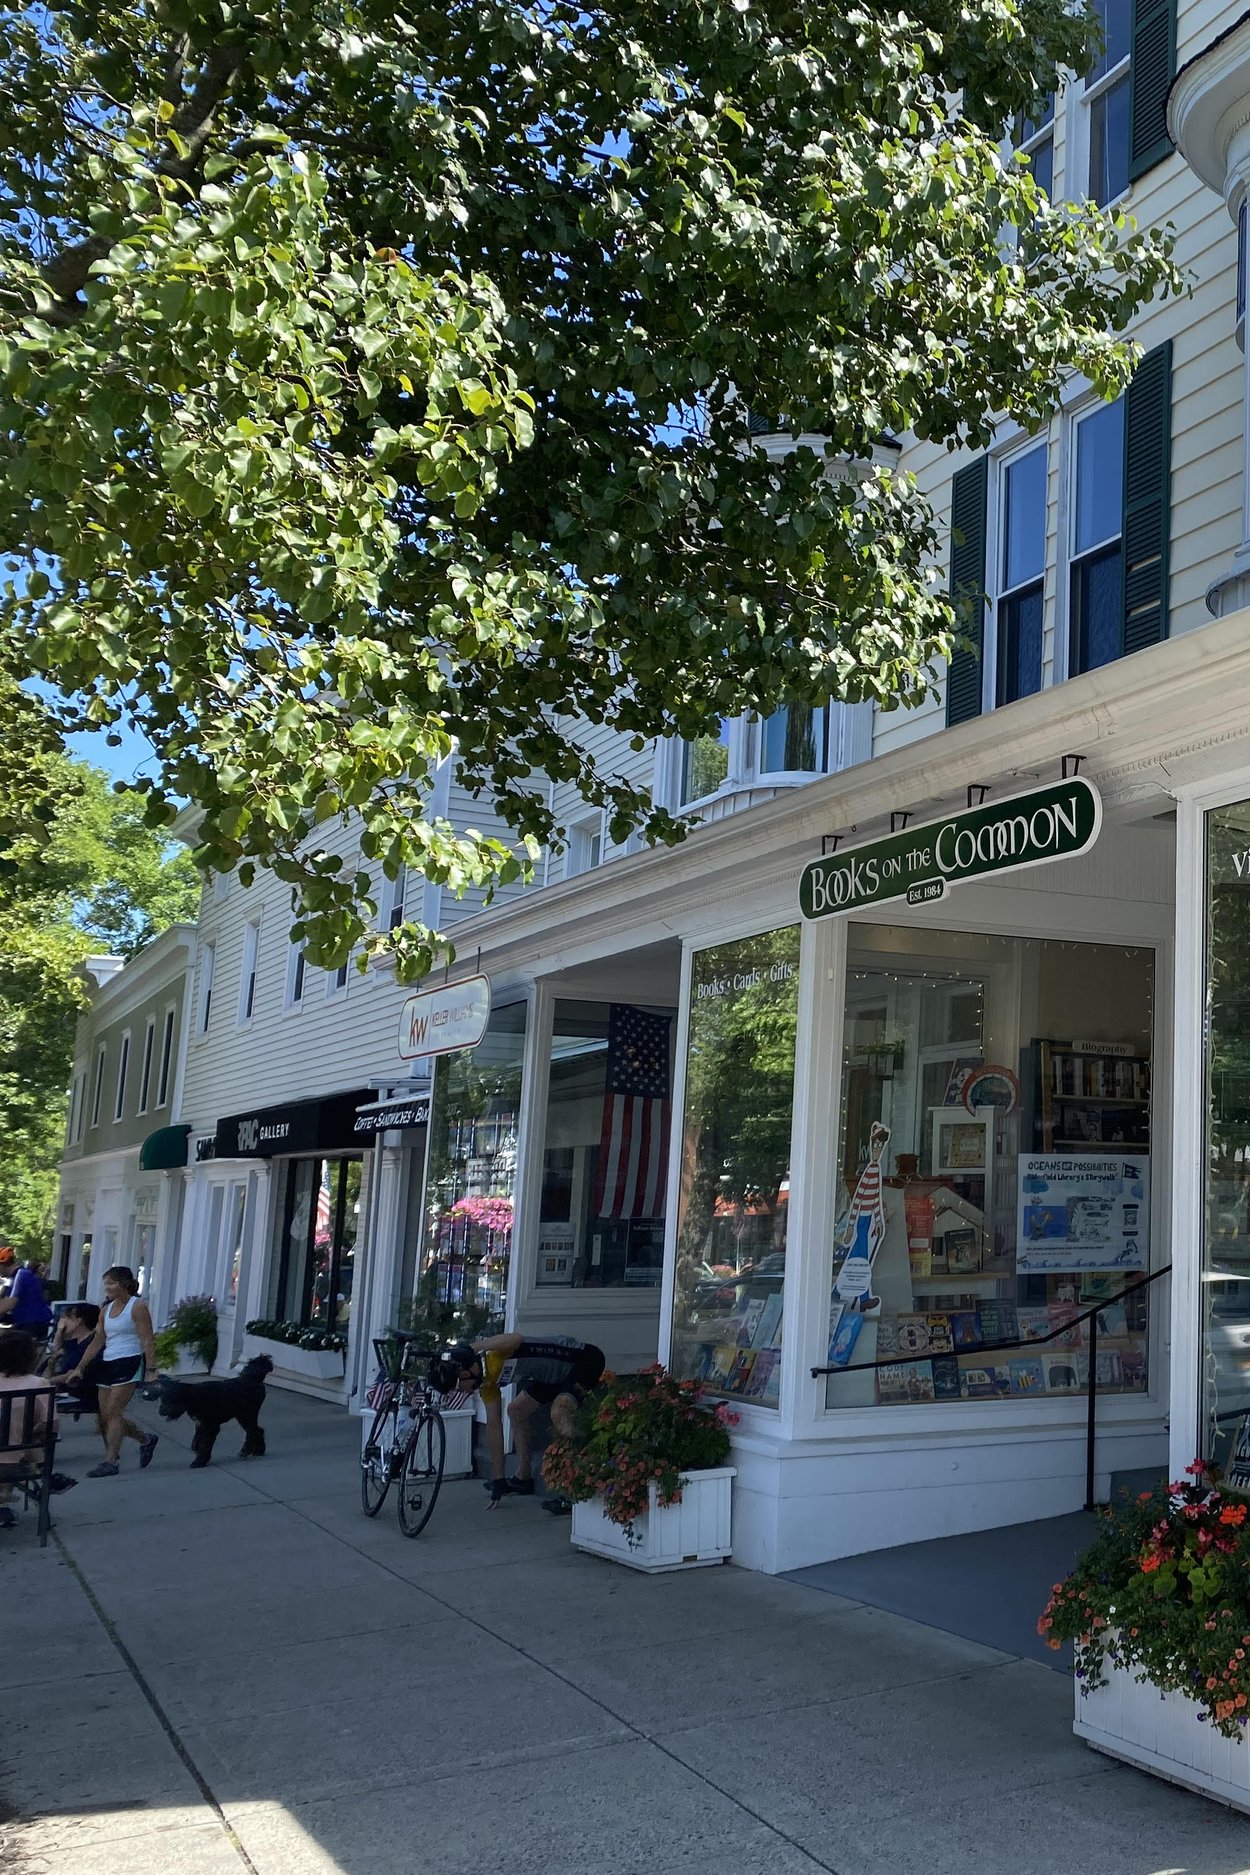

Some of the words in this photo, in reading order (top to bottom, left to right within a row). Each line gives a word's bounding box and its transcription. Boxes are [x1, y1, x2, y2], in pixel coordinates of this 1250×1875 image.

[909, 887, 922, 902] Est.
[924, 884, 942, 899] 1984
[697, 978, 725, 1000] Books
[733, 967, 761, 991] Cards
[769, 960, 793, 982] Gifts
[1081, 1042, 1128, 1055] Biography
[259, 1122, 290, 1140] GALLERY
[1028, 1161, 1062, 1171] OCEANS
